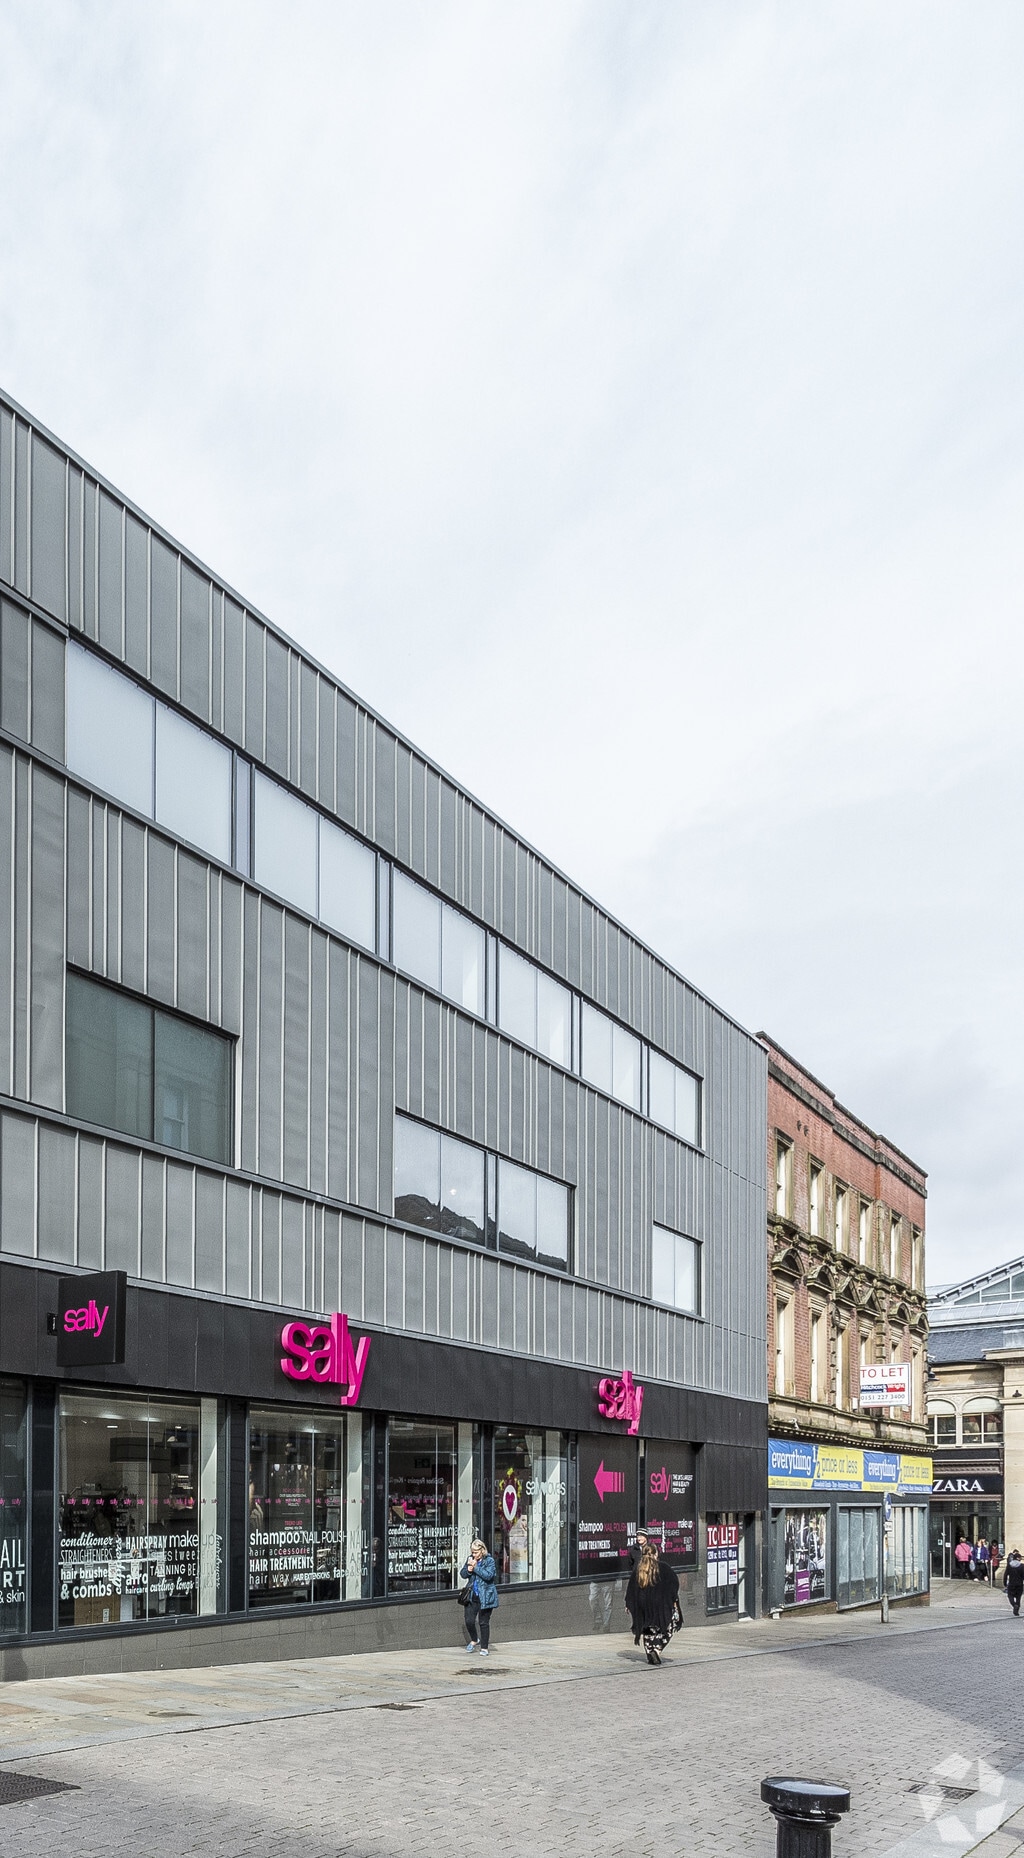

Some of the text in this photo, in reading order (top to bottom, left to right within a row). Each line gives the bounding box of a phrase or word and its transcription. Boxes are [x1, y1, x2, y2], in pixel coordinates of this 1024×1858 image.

[64, 1300, 109, 1338] sally
[280, 1312, 372, 1406] sally
[860, 1367, 904, 1378] TO LET
[598, 1370, 644, 1435] sally
[772, 1449, 858, 1476] everything price or less
[868, 1459, 929, 1481] everything price or less
[650, 1466, 671, 1501] sally
[932, 1479, 984, 1492] ZARA
[388, 1524, 417, 1535] conditioner
[578, 1520, 603, 1534] shampoo
[60, 1531, 113, 1547] conditioner
[126, 1535, 167, 1550] HAIRSPRAY
[169, 1530, 199, 1548] make
[250, 1529, 300, 1547] shampoo
[302, 1531, 320, 1544] NAIL
[322, 1530, 347, 1543] POLISH
[424, 1539, 451, 1548] EYELASHES
[707, 1526, 736, 1546] TO LET
[249, 1547, 265, 1558] hair
[578, 1541, 588, 1550] HAIR
[588, 1540, 611, 1549] TREATMENTS
[60, 1549, 113, 1562] STRAIGHTENERS
[388, 1551, 398, 1560] hair
[398, 1549, 417, 1559] brushes
[424, 1550, 437, 1565] afro
[250, 1559, 268, 1573] HAIR
[270, 1556, 314, 1571] TREATMENTS
[388, 1561, 394, 1574] &
[395, 1559, 417, 1573] combs
[60, 1567, 77, 1580] hair
[249, 1574, 268, 1585] hair
[272, 1573, 290, 1583] wax
[60, 1580, 112, 1600] & combs
[150, 1578, 176, 1596] curling
[176, 1576, 195, 1595] tongs
[6, 1589, 25, 1604] skin
